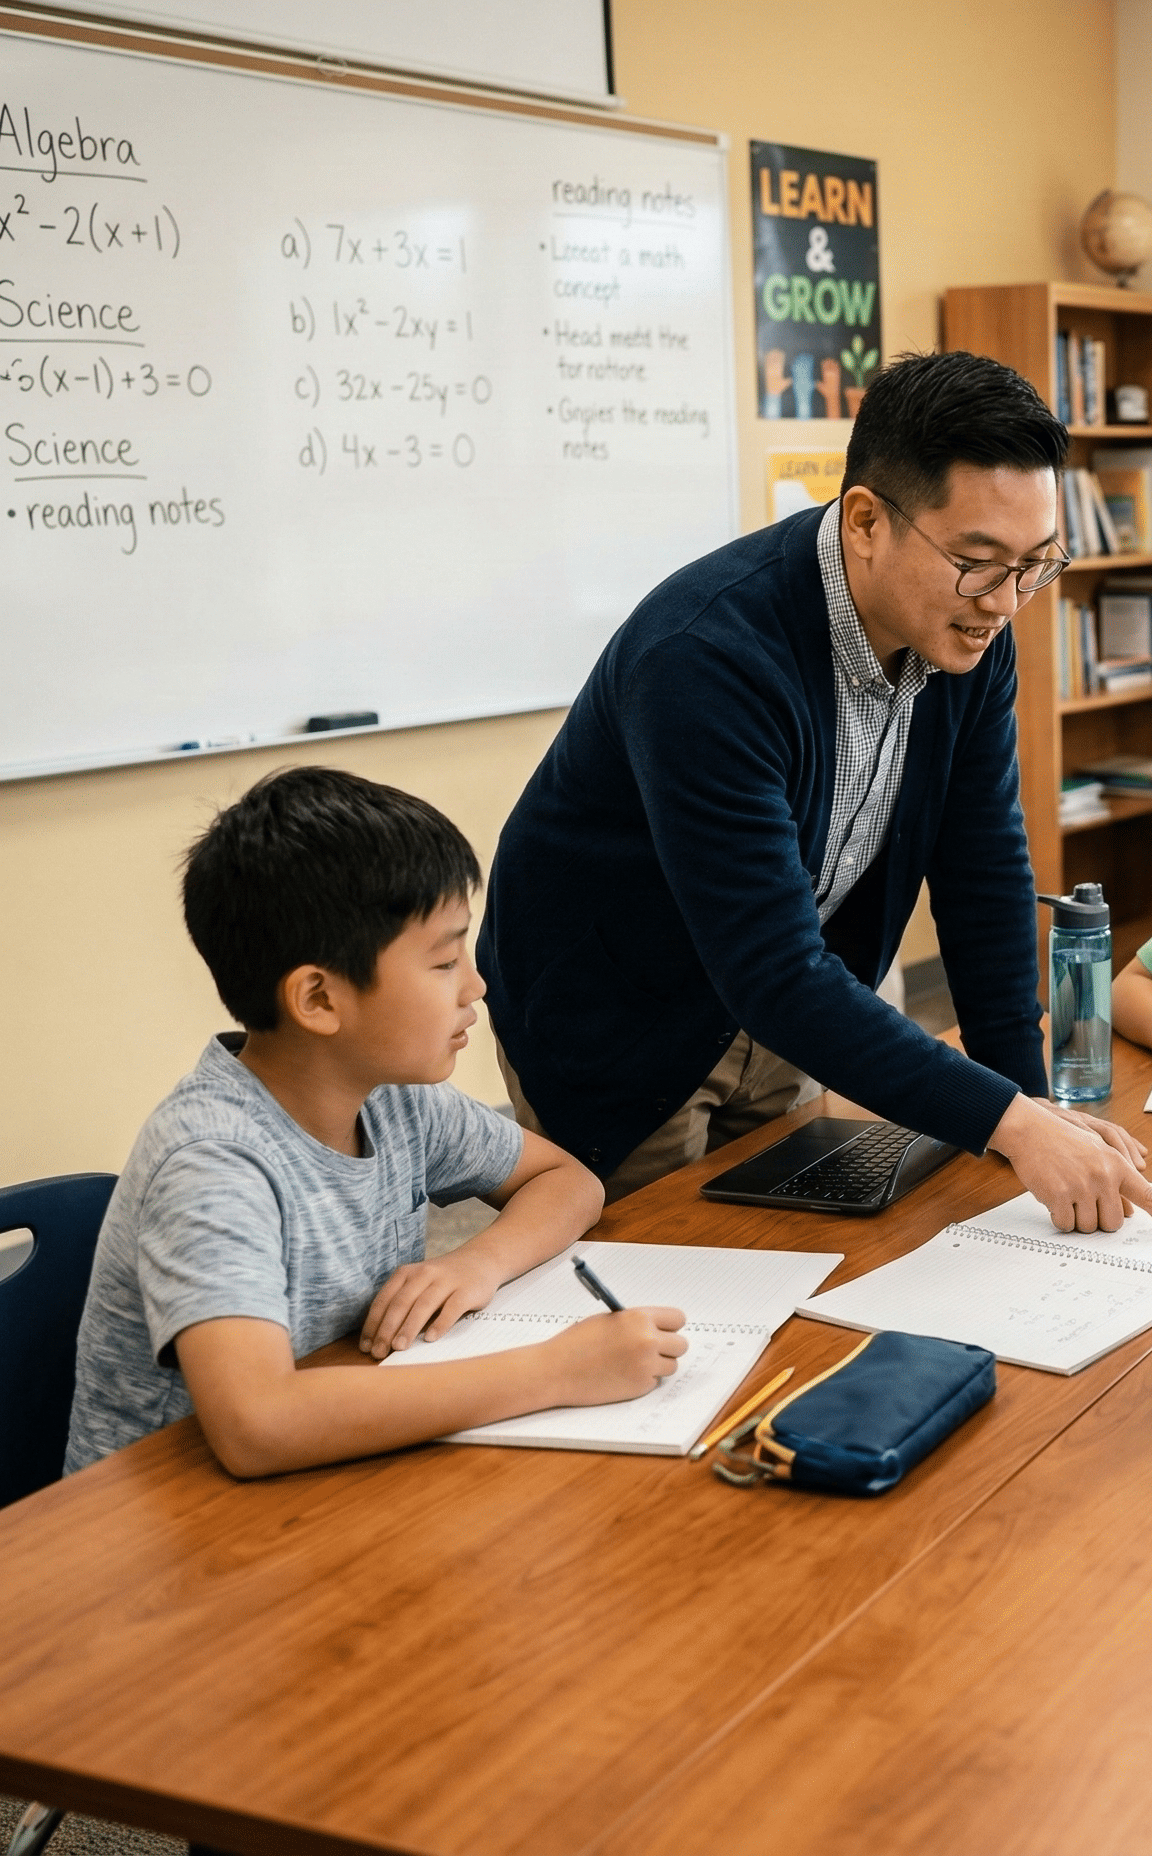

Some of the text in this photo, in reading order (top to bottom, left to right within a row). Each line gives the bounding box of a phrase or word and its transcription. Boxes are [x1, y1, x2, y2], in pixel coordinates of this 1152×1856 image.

[0, 103, 141, 183] Algebra
[551, 174, 696, 229] reading notes
[759, 166, 873, 229] LEARN
[281, 217, 311, 270] a)
[805, 225, 836, 273] &
[0, 279, 141, 333] Science
[290, 295, 316, 343] b)
[763, 273, 876, 327] GROW
[294, 364, 321, 409] c)
[5, 422, 140, 467] Science
[299, 426, 329, 476] d)
[26, 486, 226, 555] reading notes
